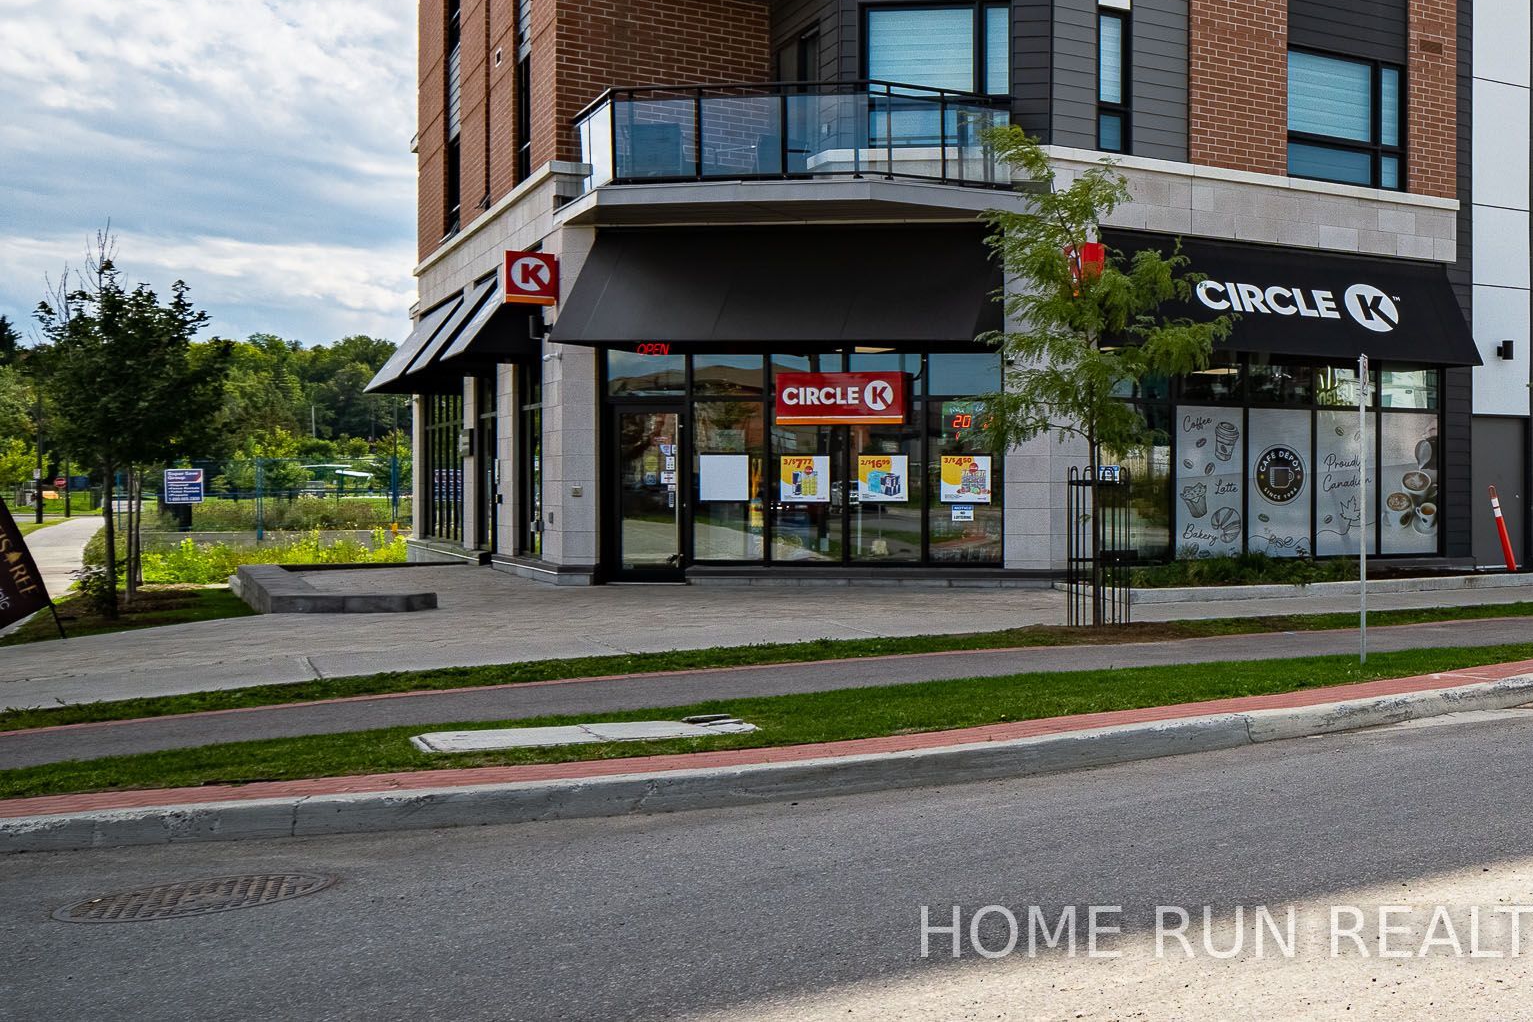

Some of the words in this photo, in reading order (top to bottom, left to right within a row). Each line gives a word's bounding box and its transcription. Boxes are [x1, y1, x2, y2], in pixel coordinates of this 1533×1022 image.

[1196, 280, 1341, 319] CIRCLE
[636, 343, 671, 355] OPEN
[782, 386, 859, 406] CIRCLE
[951, 414, 972, 429] 20
[1182, 414, 1213, 433] Coffee
[1214, 479, 1239, 495] Latte
[1182, 523, 1217, 546] Bakery
